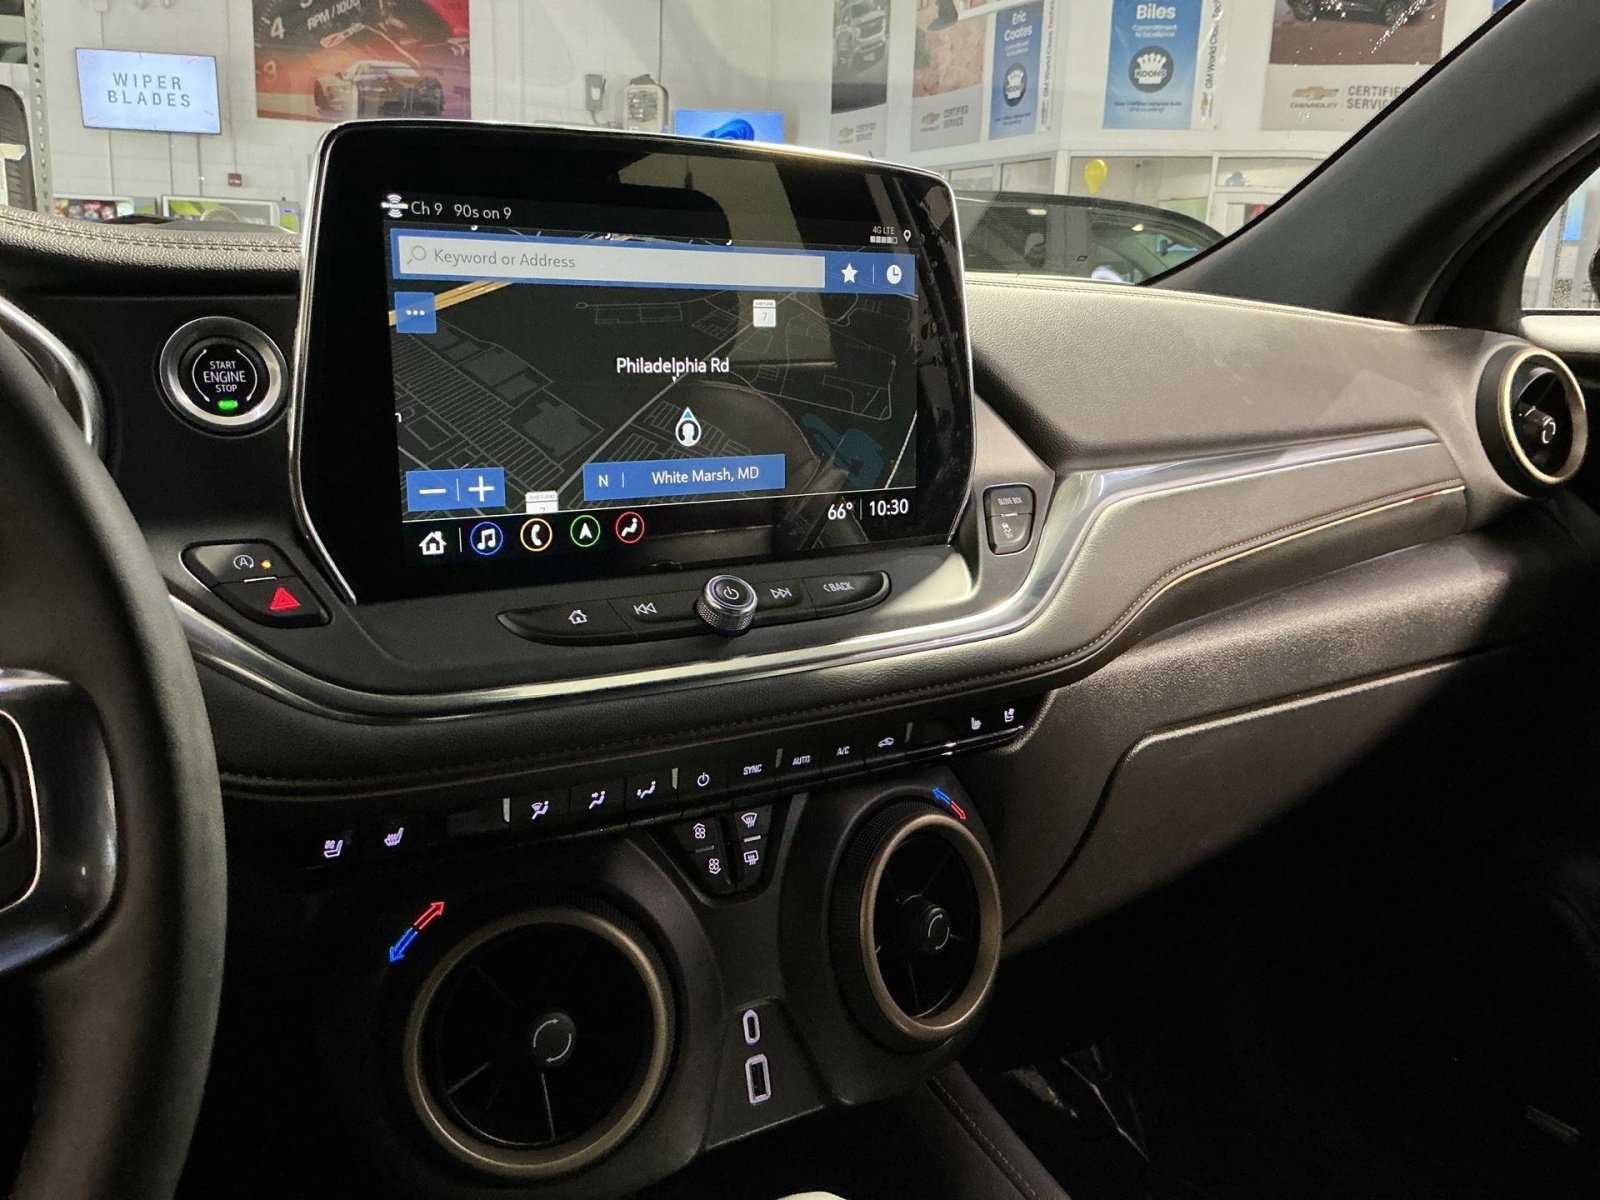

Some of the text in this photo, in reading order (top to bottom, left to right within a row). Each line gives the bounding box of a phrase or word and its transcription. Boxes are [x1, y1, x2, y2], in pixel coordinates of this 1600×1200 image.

[1011, 10, 1027, 25] Eric
[1136, 3, 1176, 19] Biles
[270, 16, 285, 39] 4
[1135, 70, 1165, 78] KOONS
[112, 72, 182, 91] WIPER
[1347, 85, 1408, 96] CERTIFIE
[107, 89, 191, 107] BLADES
[411, 201, 430, 215] Ch
[434, 203, 442, 215] 9
[454, 204, 479, 218] 90s
[483, 209, 500, 219] on
[503, 207, 512, 219] 9
[872, 226, 895, 235] 4G LTE
[434, 249, 576, 268] Keyword or Address
[210, 360, 236, 370] START
[616, 356, 730, 378] Philadelphia Rd
[203, 370, 247, 383] ENGINE
[215, 383, 238, 393] STOP
[598, 474, 609, 488] N
[652, 466, 759, 485] White Marsh, MD
[869, 498, 909, 516] 10:30
[828, 581, 855, 592] BACK
[836, 746, 851, 756] A/C
[792, 755, 811, 766] AUTO
[743, 763, 763, 776] SYNC
